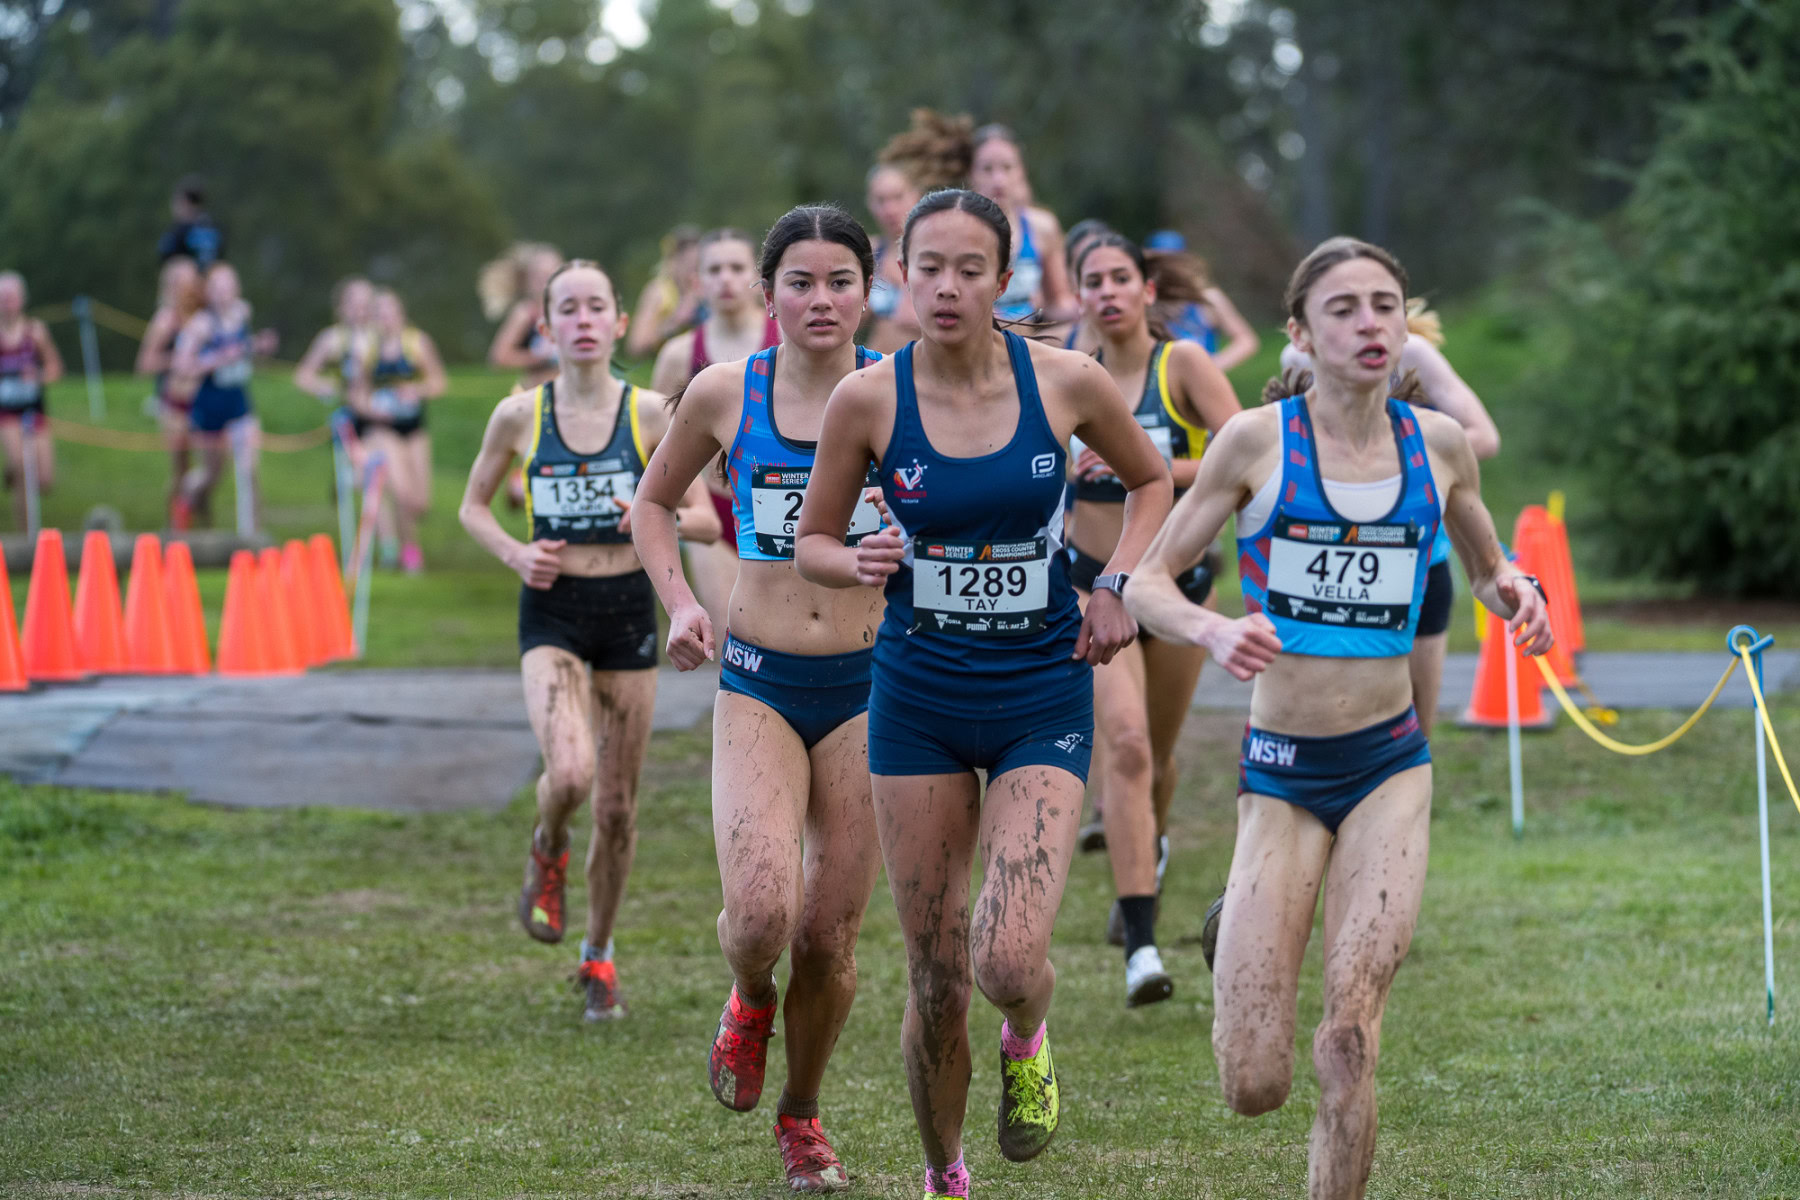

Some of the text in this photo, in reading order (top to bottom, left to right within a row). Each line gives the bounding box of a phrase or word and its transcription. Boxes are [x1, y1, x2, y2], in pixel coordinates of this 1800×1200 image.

[550, 479, 615, 503] 1354
[992, 550, 1036, 558] CHAMPIONSHIPS
[1306, 549, 1379, 585] 479
[938, 565, 1027, 597] 1289
[1312, 585, 1370, 600] VELLA
[965, 598, 998, 611] TAY
[966, 623, 987, 631] PUMA
[725, 642, 762, 672] NSW
[1249, 737, 1297, 766] NSW
